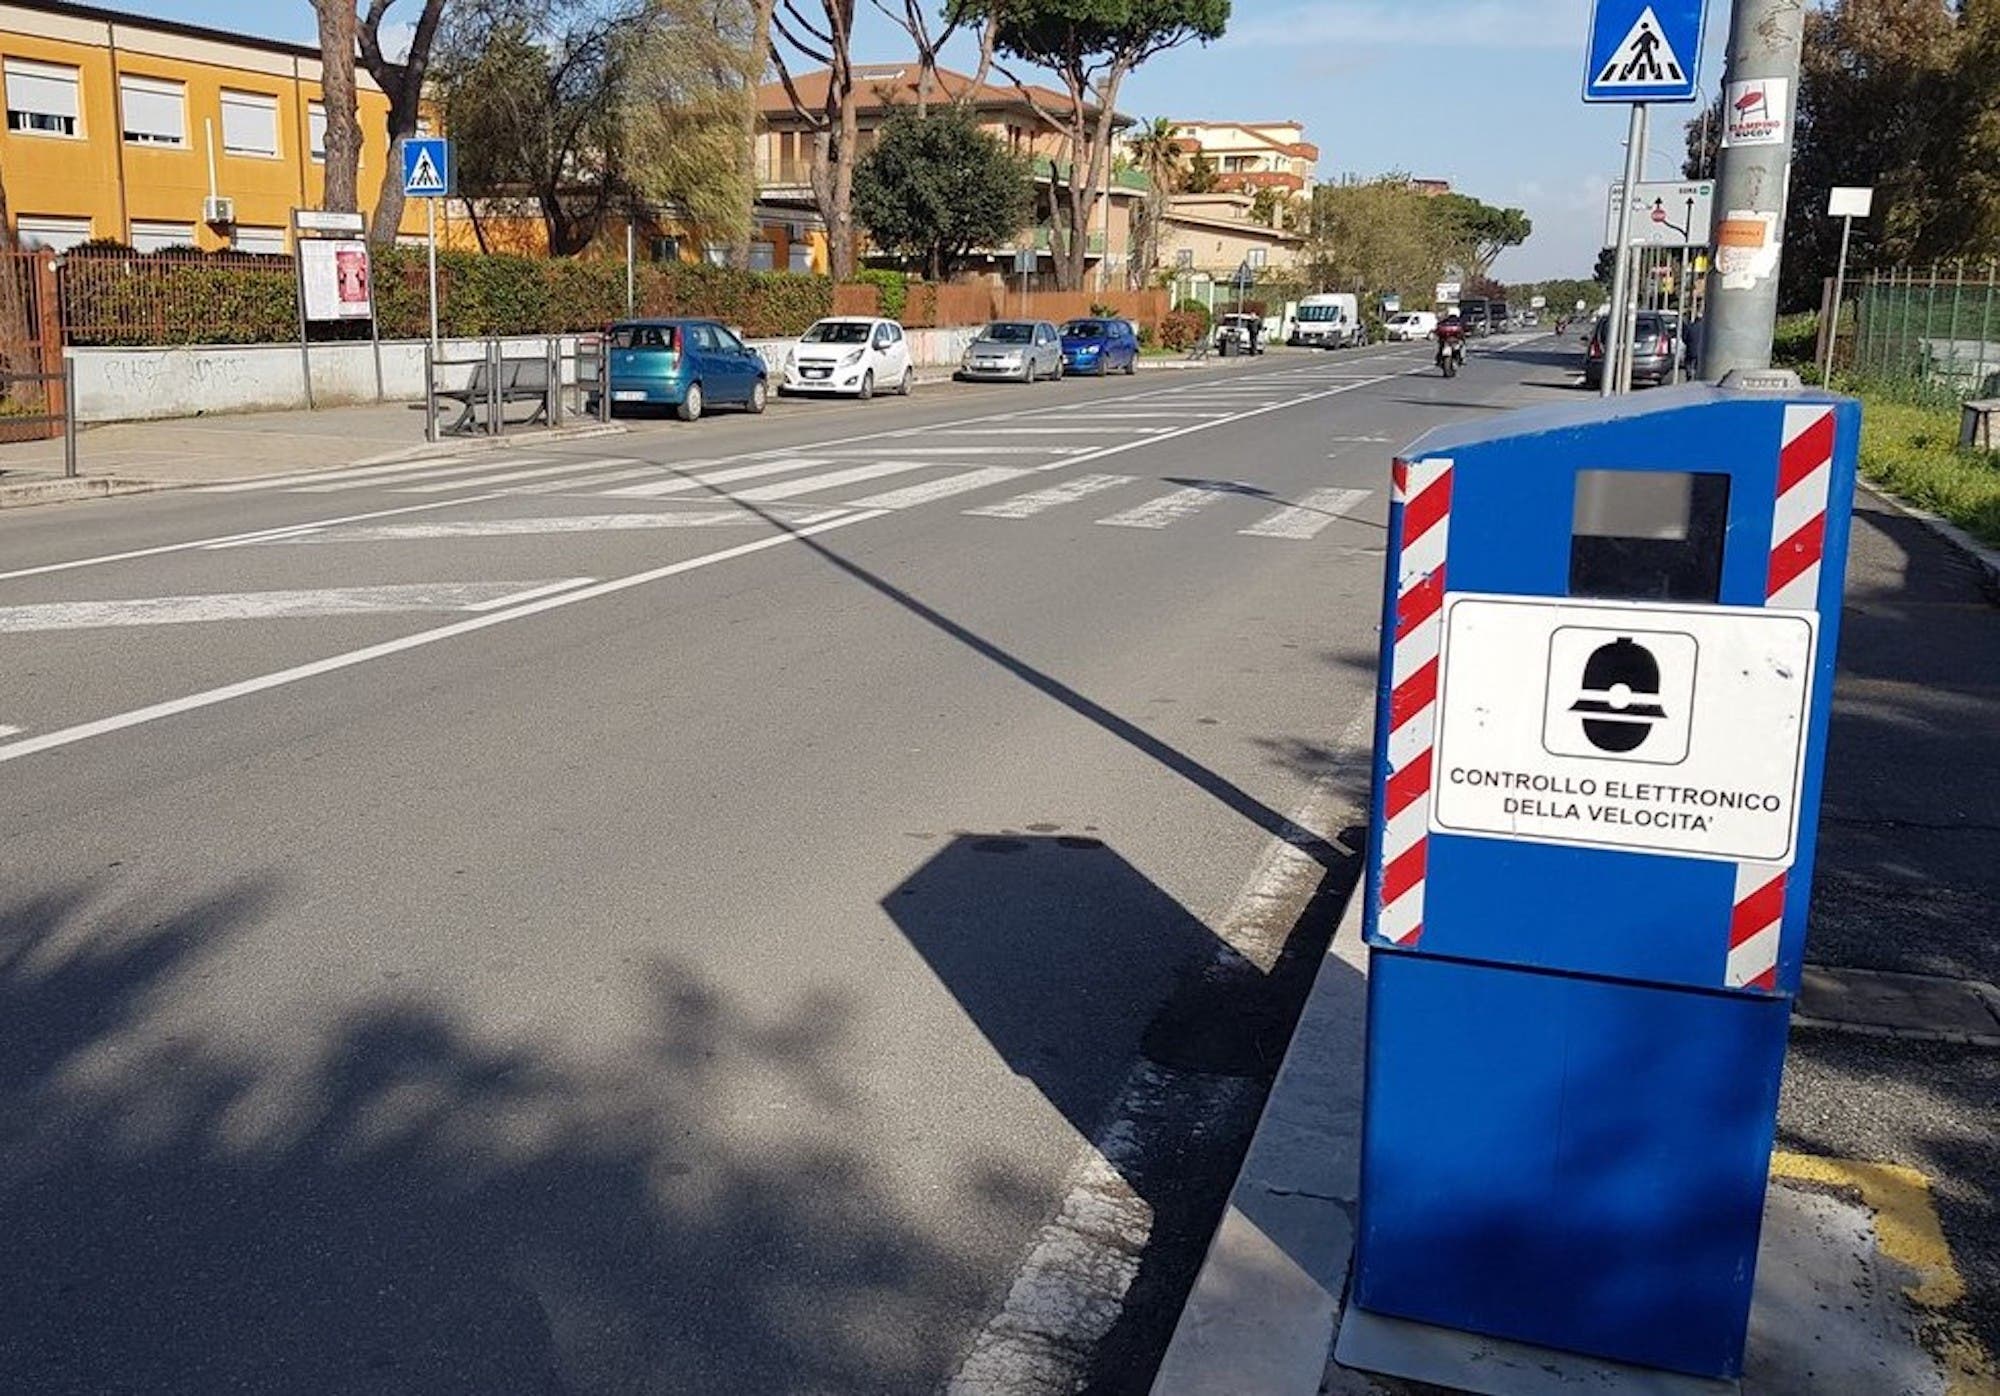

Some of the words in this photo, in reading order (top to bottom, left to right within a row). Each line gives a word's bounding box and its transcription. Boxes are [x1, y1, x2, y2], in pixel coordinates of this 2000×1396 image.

[1450, 767, 1597, 796] CONTROLLO
[1605, 781, 1781, 812] ELETTRONICO
[1503, 797, 1580, 820] DELLA
[1588, 805, 1714, 832] VELOCITA'
